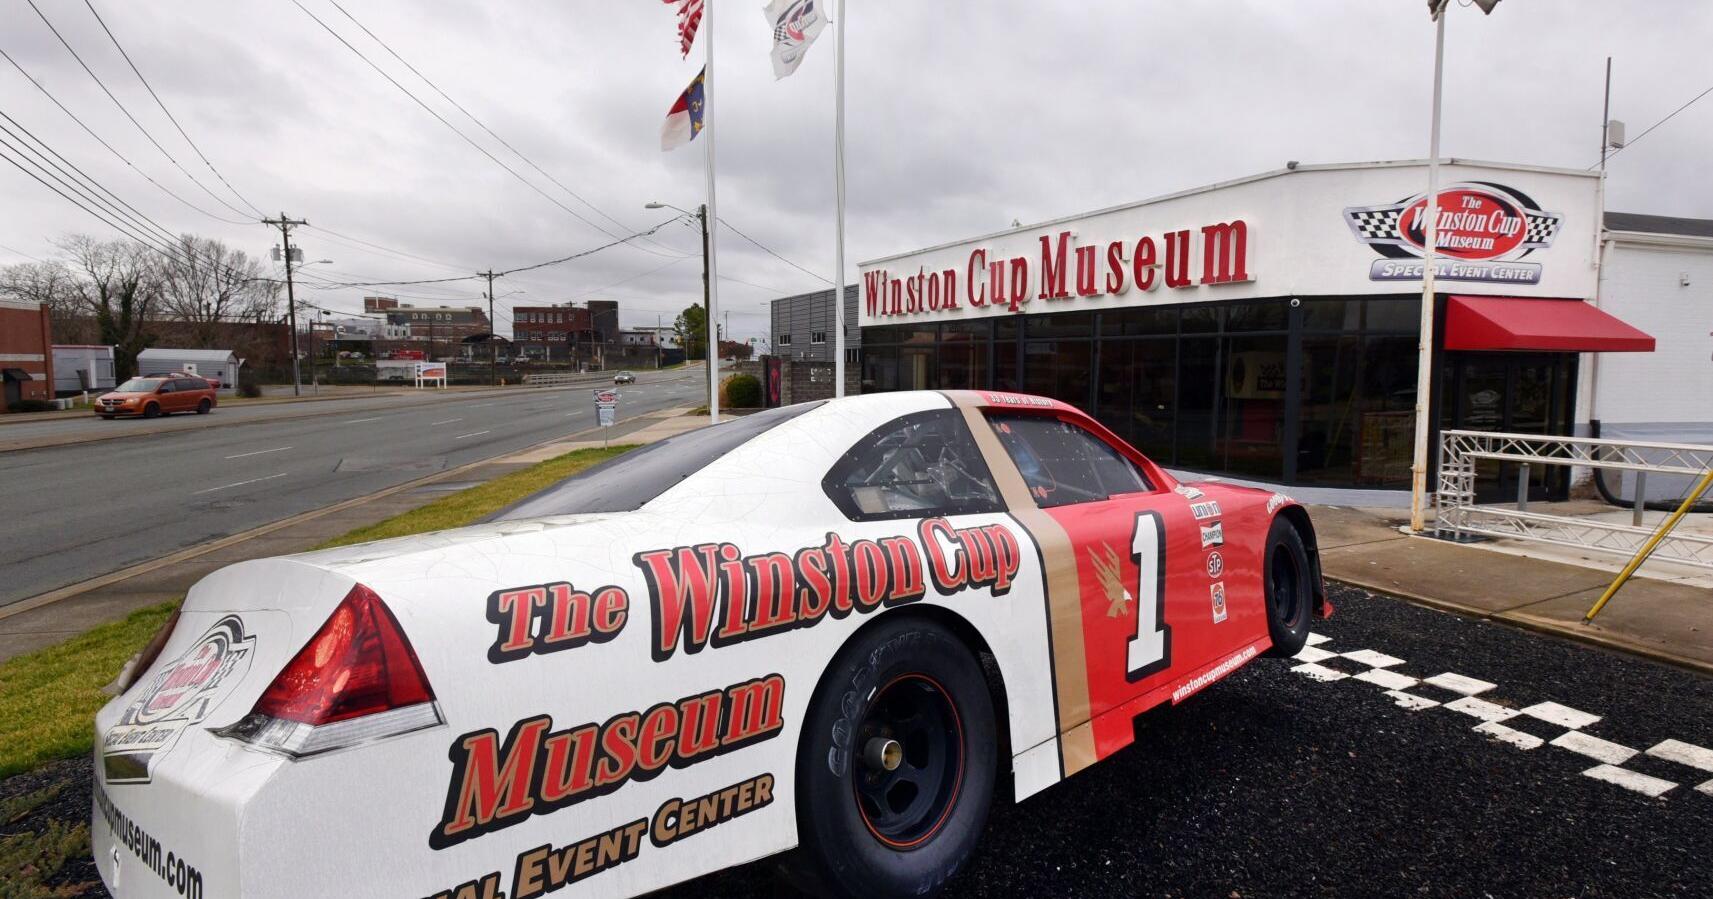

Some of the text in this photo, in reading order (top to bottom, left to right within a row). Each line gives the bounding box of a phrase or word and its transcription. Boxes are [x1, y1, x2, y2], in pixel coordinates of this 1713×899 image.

[1410, 206, 1521, 238] Winston Cup
[1462, 195, 1482, 209] The
[864, 219, 1254, 318] Winston Cup Museum
[1435, 231, 1495, 250] Museum
[1381, 262, 1534, 280] SPECAL EVENT CENTER
[486, 516, 1021, 664] The Winston Cup
[1208, 554, 1222, 573] STP
[1126, 510, 1172, 684] 1
[1172, 645, 1257, 701] winstoncupmuseum.com
[429, 673, 786, 850] Museum
[510, 772, 775, 899] EVENT CENTER
